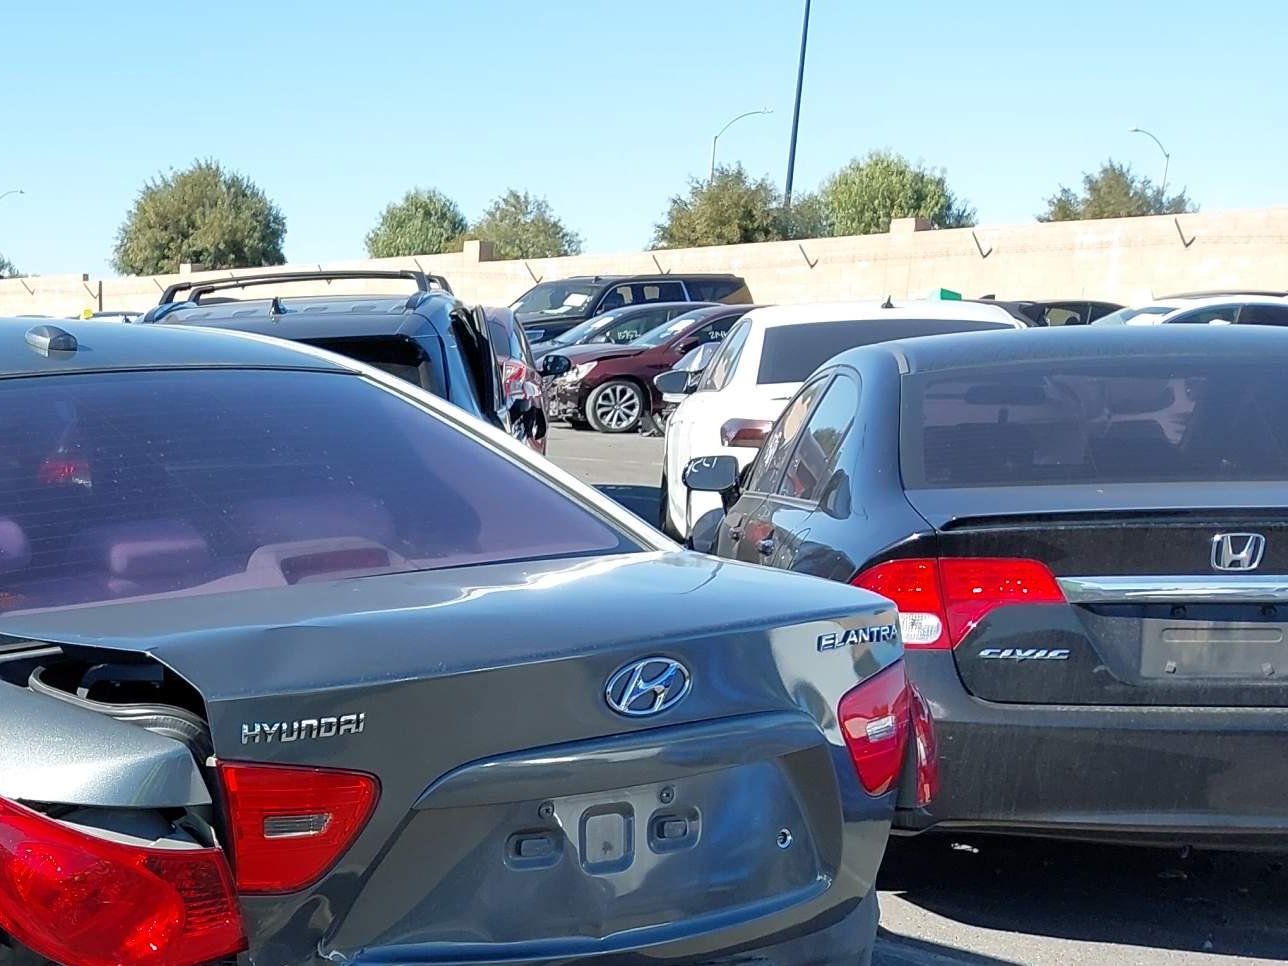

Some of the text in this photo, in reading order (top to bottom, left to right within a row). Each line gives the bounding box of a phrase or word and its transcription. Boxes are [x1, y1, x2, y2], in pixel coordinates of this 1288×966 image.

[817, 625, 898, 652] ELANTRA
[978, 649, 1070, 661] CIVIC
[241, 712, 366, 745] HYUNDAI
